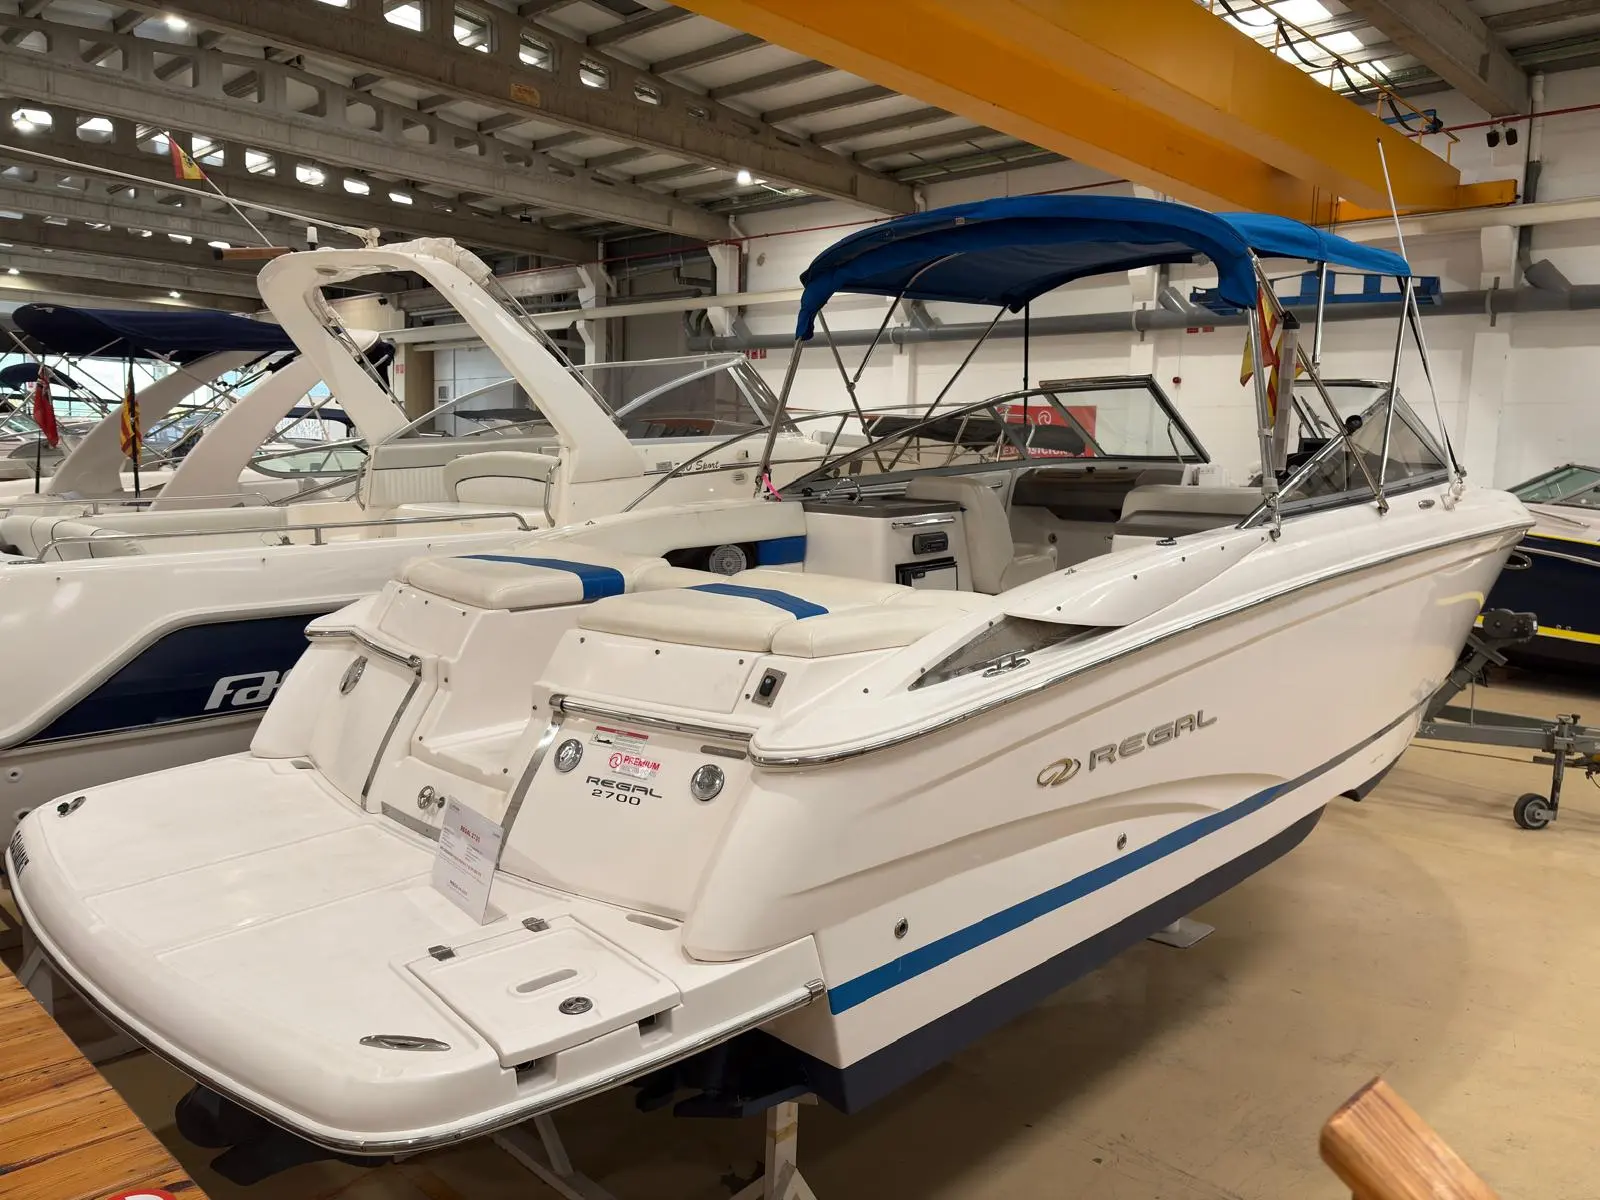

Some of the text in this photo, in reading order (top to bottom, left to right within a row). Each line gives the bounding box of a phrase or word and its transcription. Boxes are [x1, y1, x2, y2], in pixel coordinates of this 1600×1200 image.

[695, 460, 720, 471] Sport
[1089, 709, 1218, 772] REGAL
[623, 755, 661, 771] PREMIUM
[585, 776, 663, 799] REGAL
[591, 788, 641, 806] 2700
